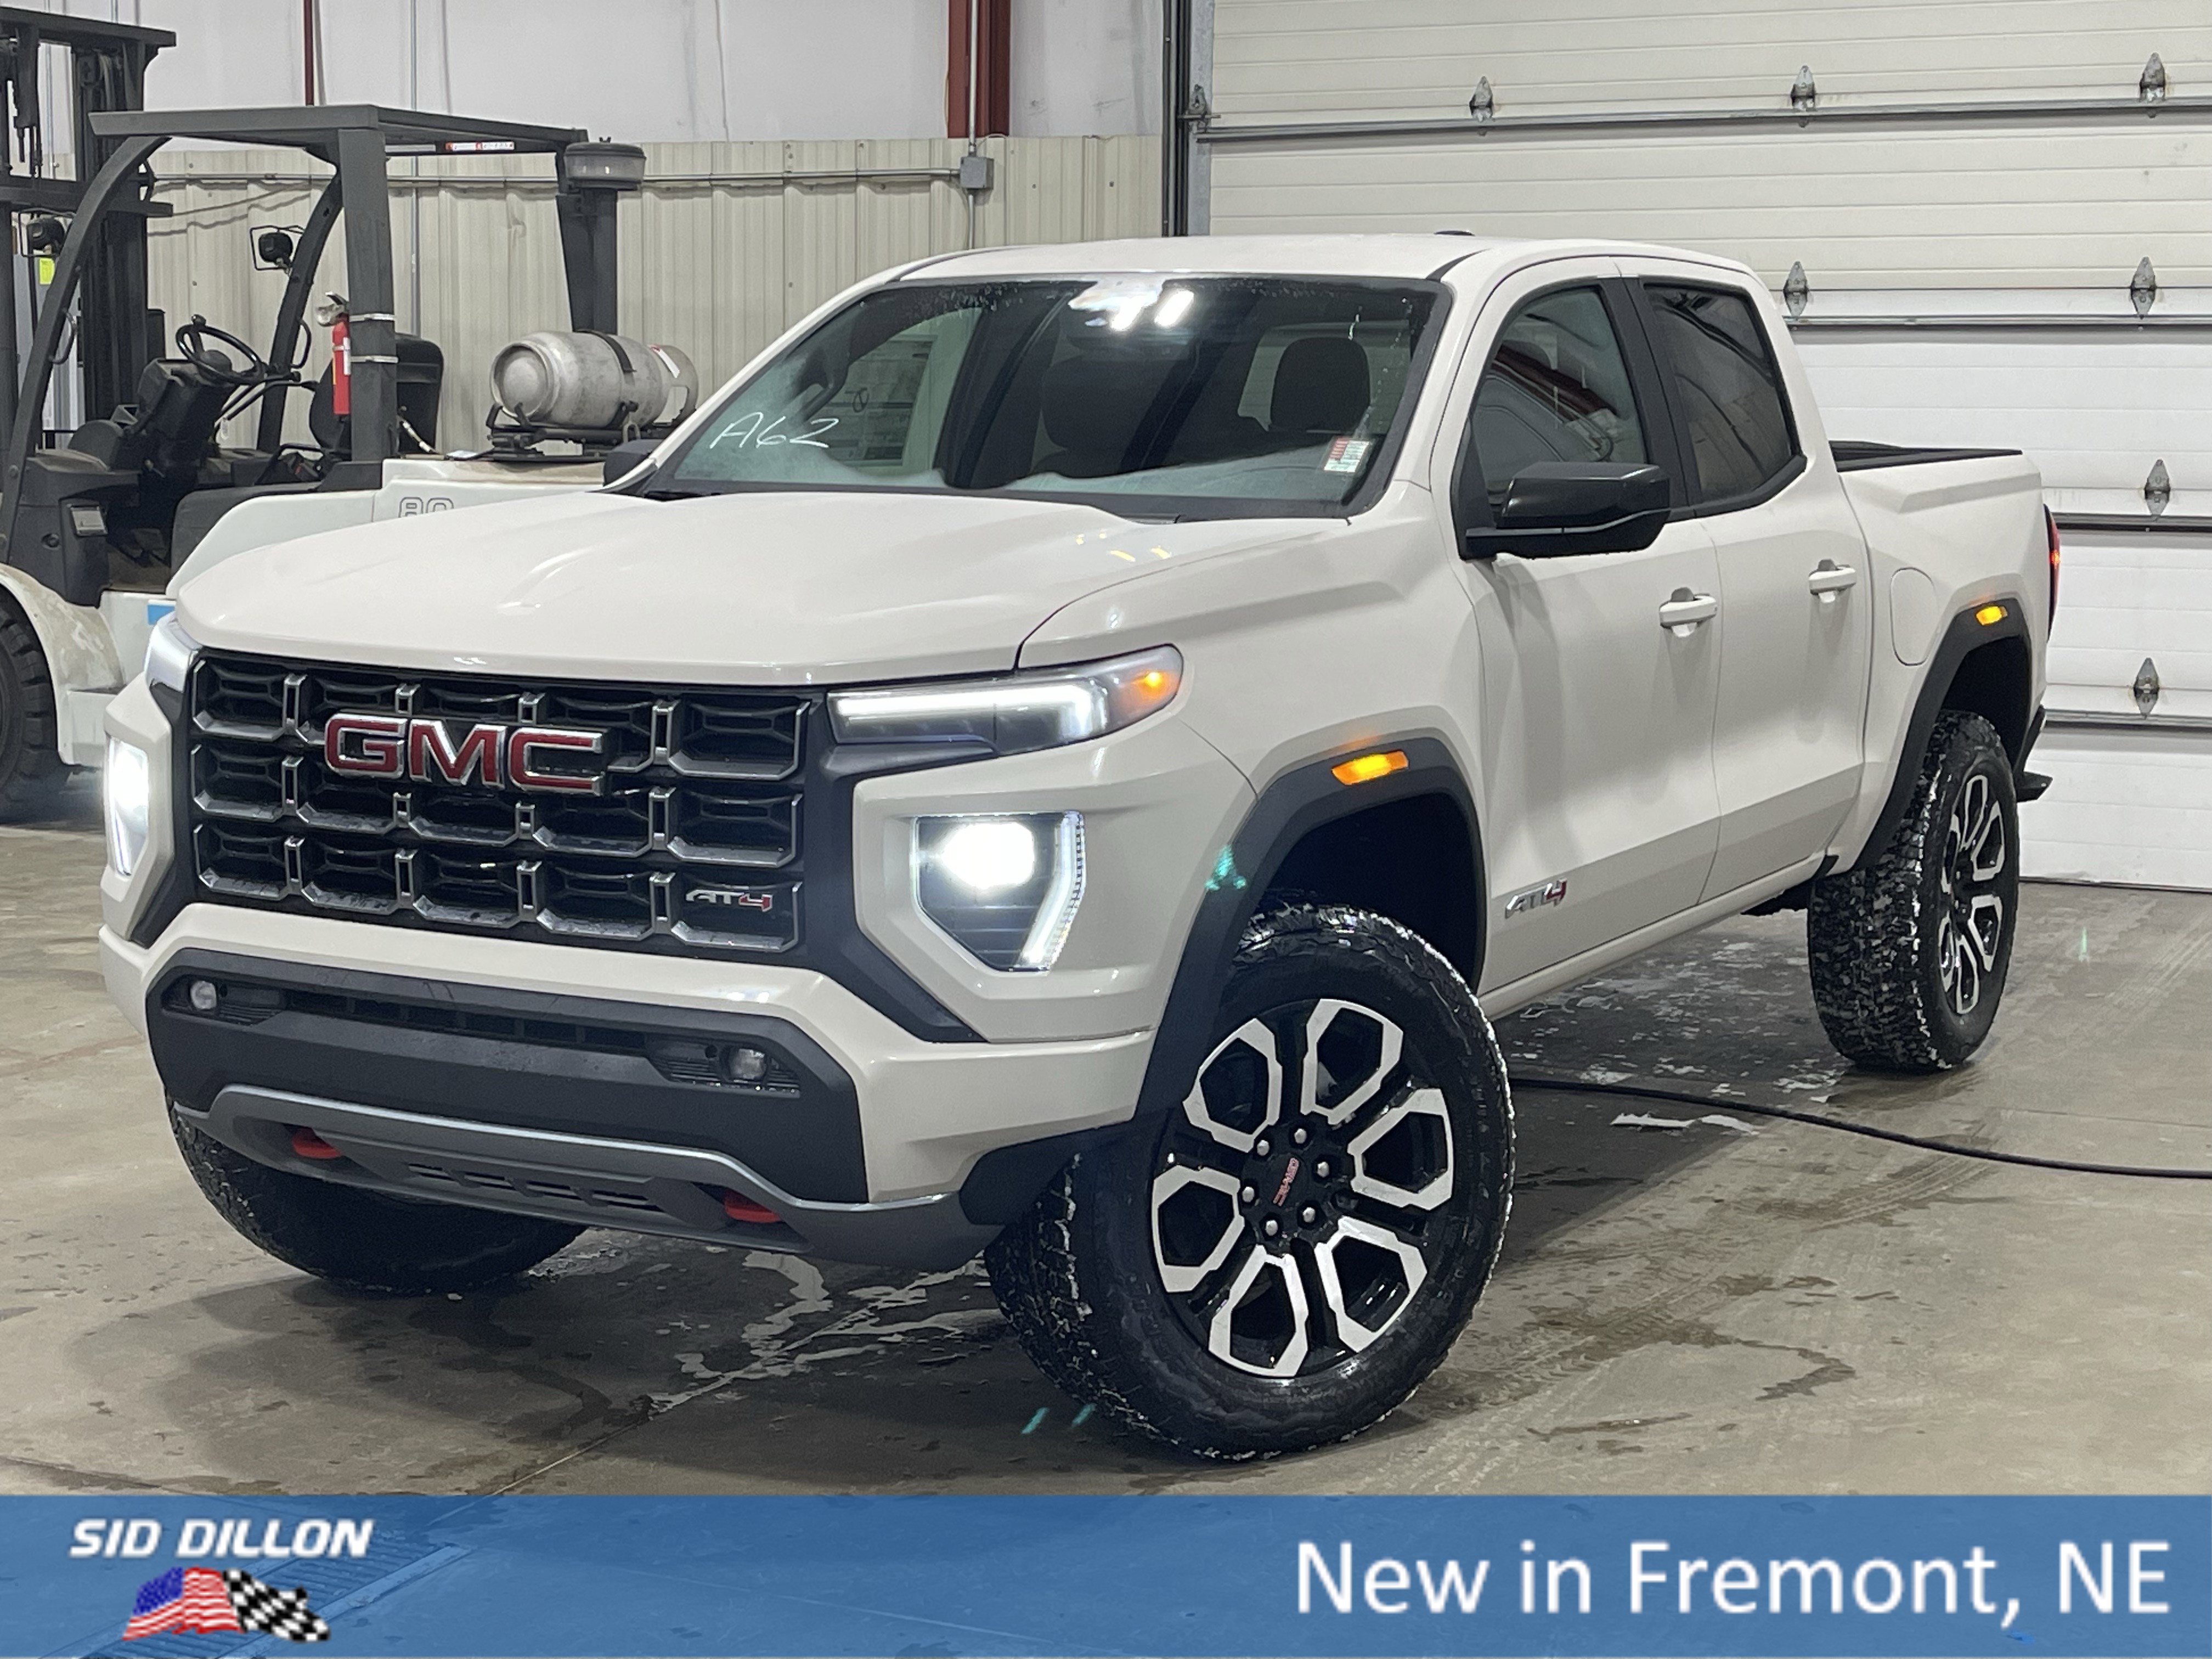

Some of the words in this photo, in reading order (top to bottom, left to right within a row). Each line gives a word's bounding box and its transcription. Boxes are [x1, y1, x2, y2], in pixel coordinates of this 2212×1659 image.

[709, 411, 839, 449] A62
[324, 713, 604, 797] GMC
[686, 889, 772, 912] AT4
[1505, 878, 1567, 919] AT4
